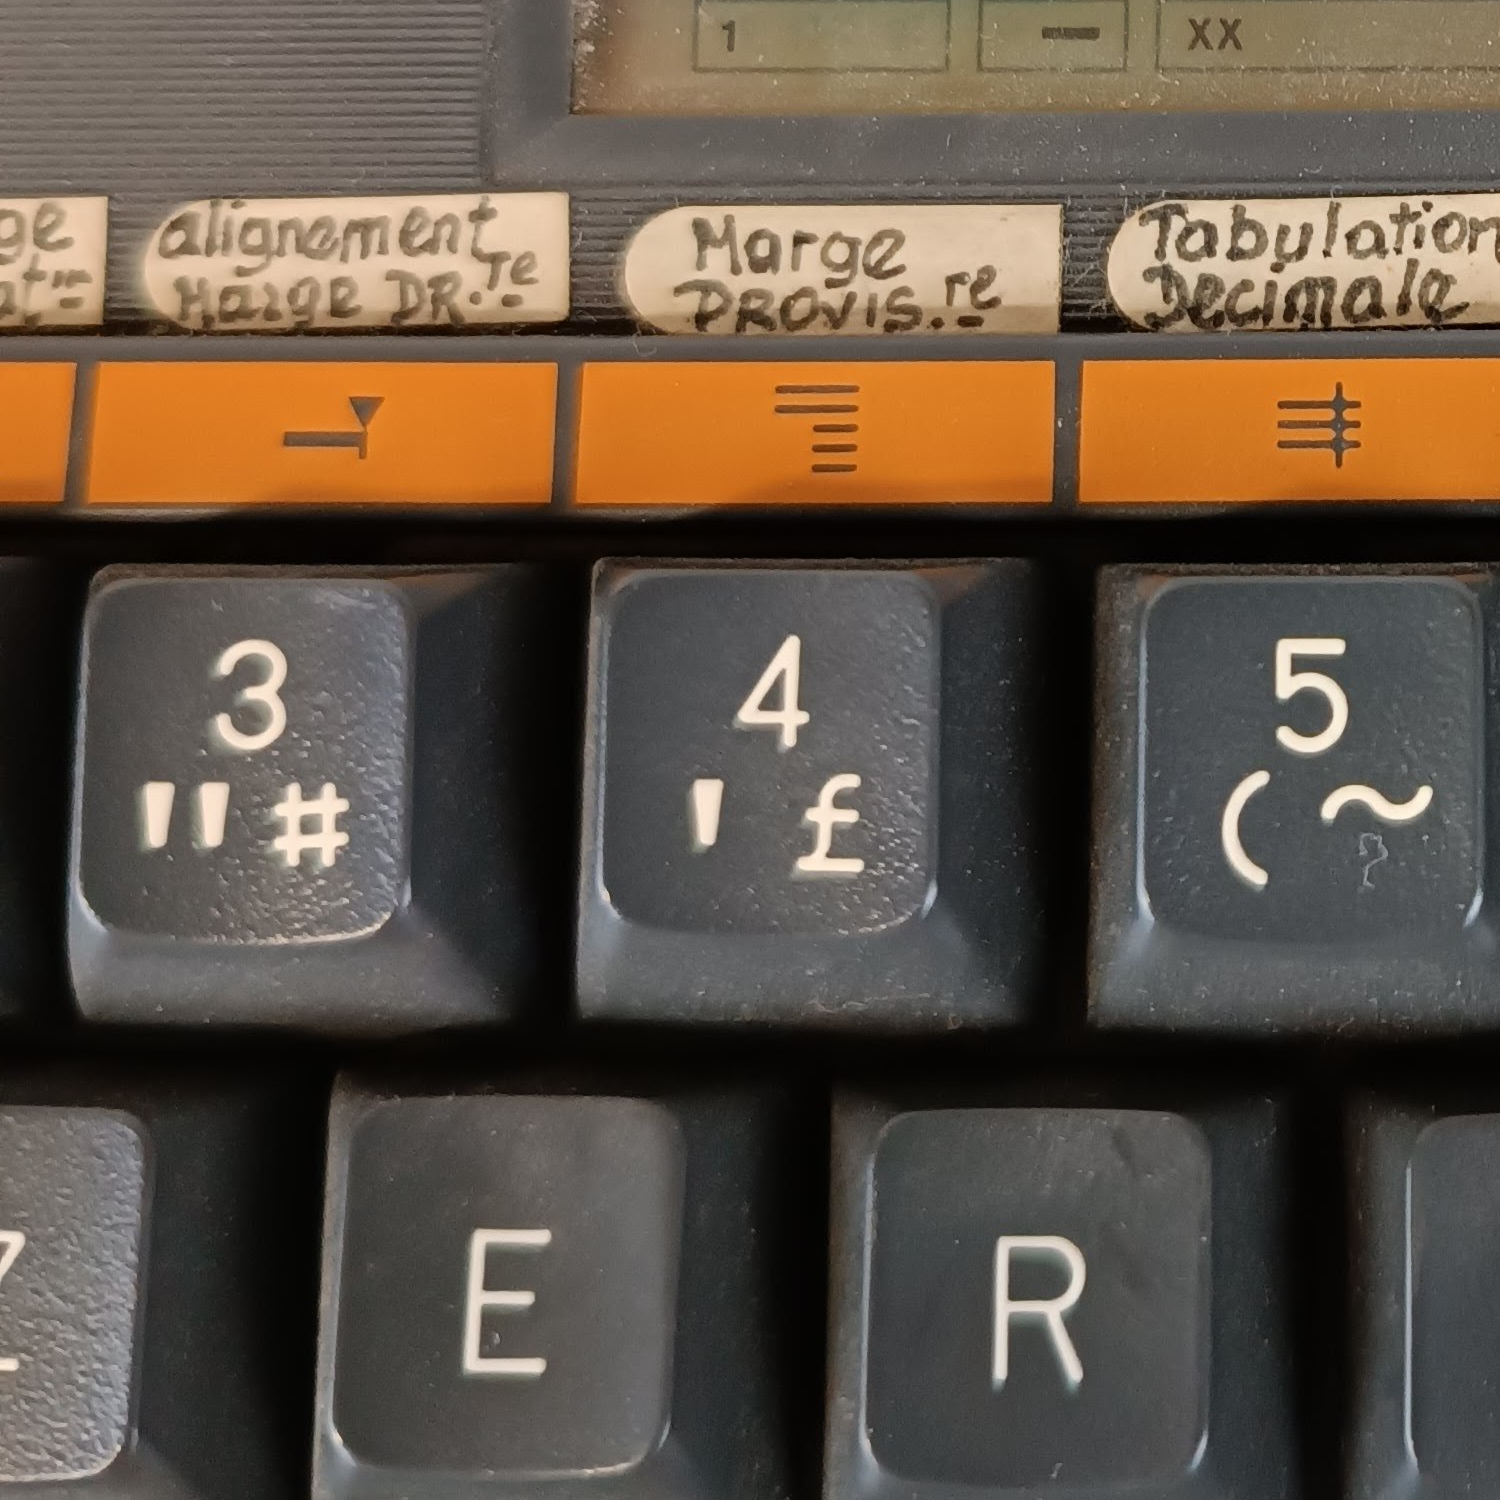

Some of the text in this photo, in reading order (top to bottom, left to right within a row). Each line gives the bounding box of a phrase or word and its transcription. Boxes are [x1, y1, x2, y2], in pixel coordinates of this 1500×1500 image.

[720, 19, 736, 52] 1
[1187, 17, 1243, 51] XX
[691, 214, 907, 289] Marge
[1143, 258, 1472, 331] Decimale
[212, 638, 288, 752] 3
[735, 634, 810, 752] 4
[1275, 637, 1349, 754] 5
[462, 1227, 552, 1377] E
[991, 1234, 1086, 1388] R
